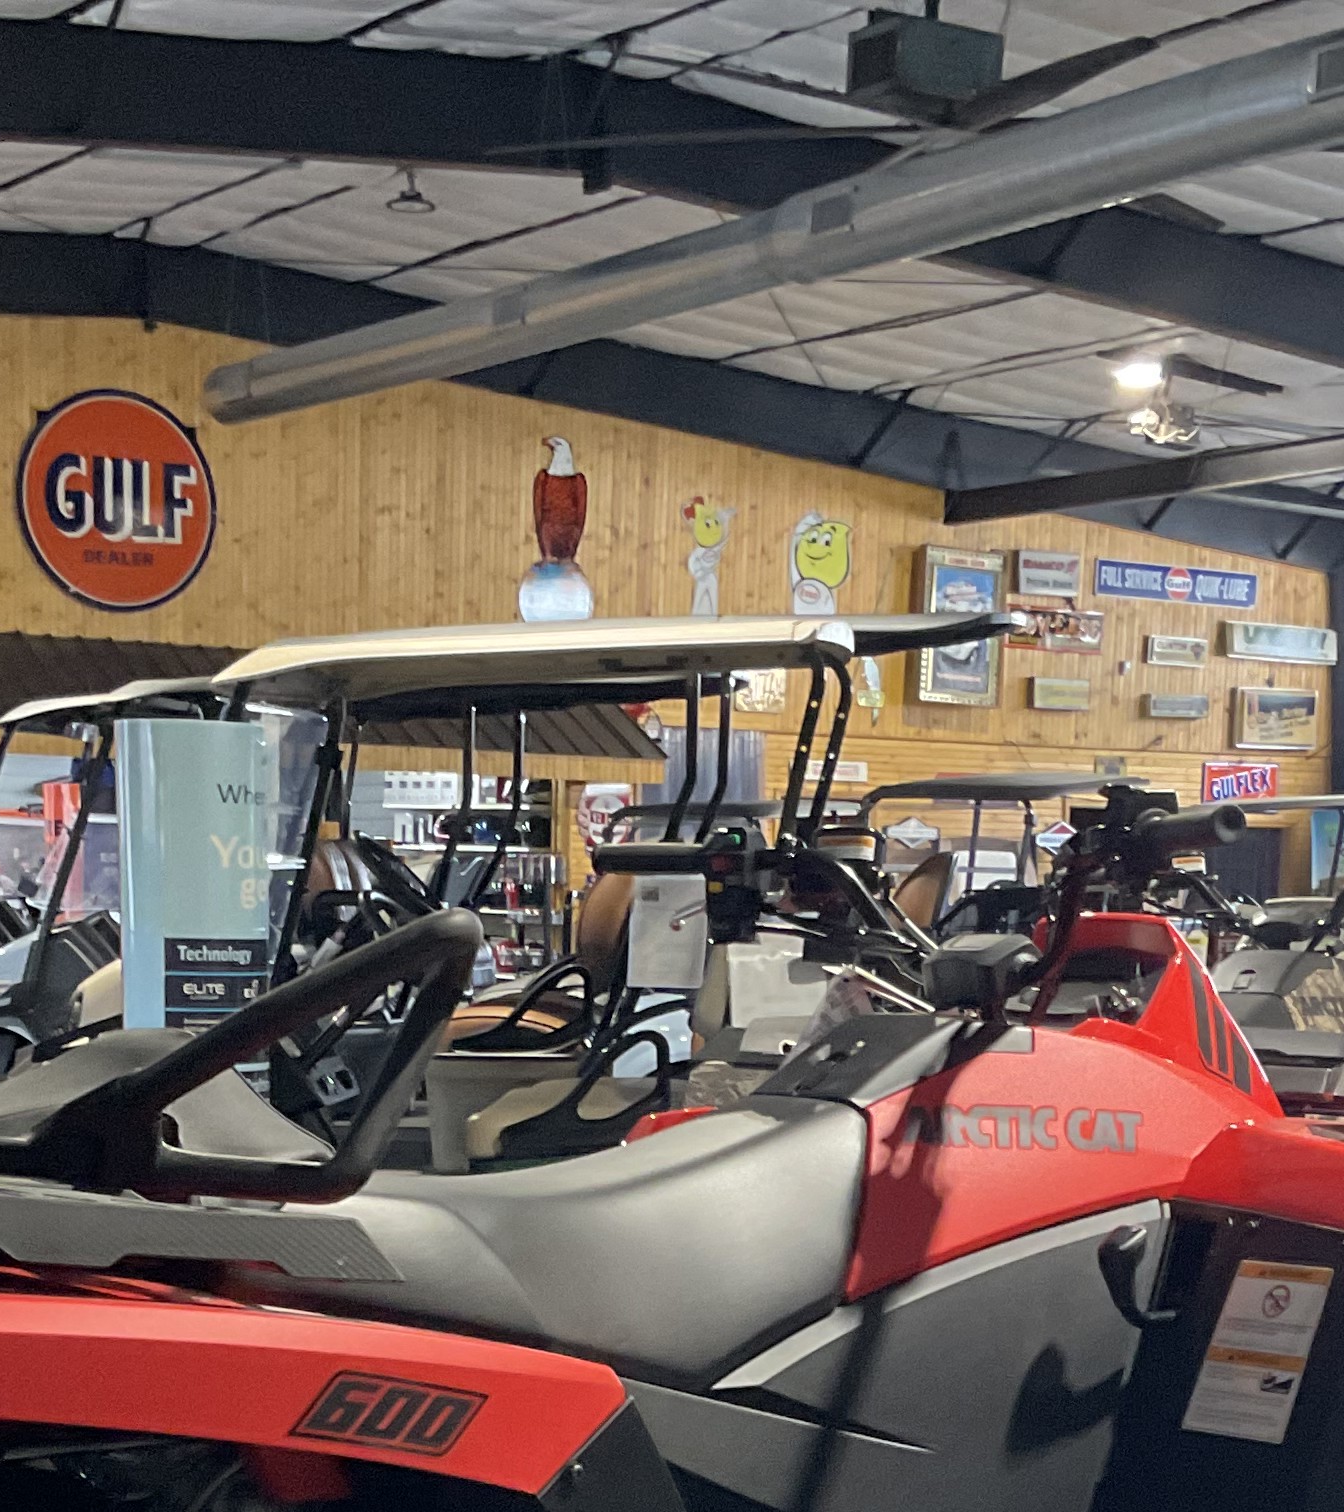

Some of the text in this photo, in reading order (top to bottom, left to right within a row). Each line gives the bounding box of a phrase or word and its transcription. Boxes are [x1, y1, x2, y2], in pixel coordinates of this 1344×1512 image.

[45, 453, 197, 544] GULF
[83, 549, 154, 566] DEALER
[1101, 566, 1122, 587] FULL
[1124, 568, 1162, 591] SERVICE
[1210, 767, 1272, 800] GULFLEX
[177, 945, 253, 966] Technology
[903, 1104, 1144, 1153] ARCTIC CAT
[304, 1379, 475, 1449] 600
